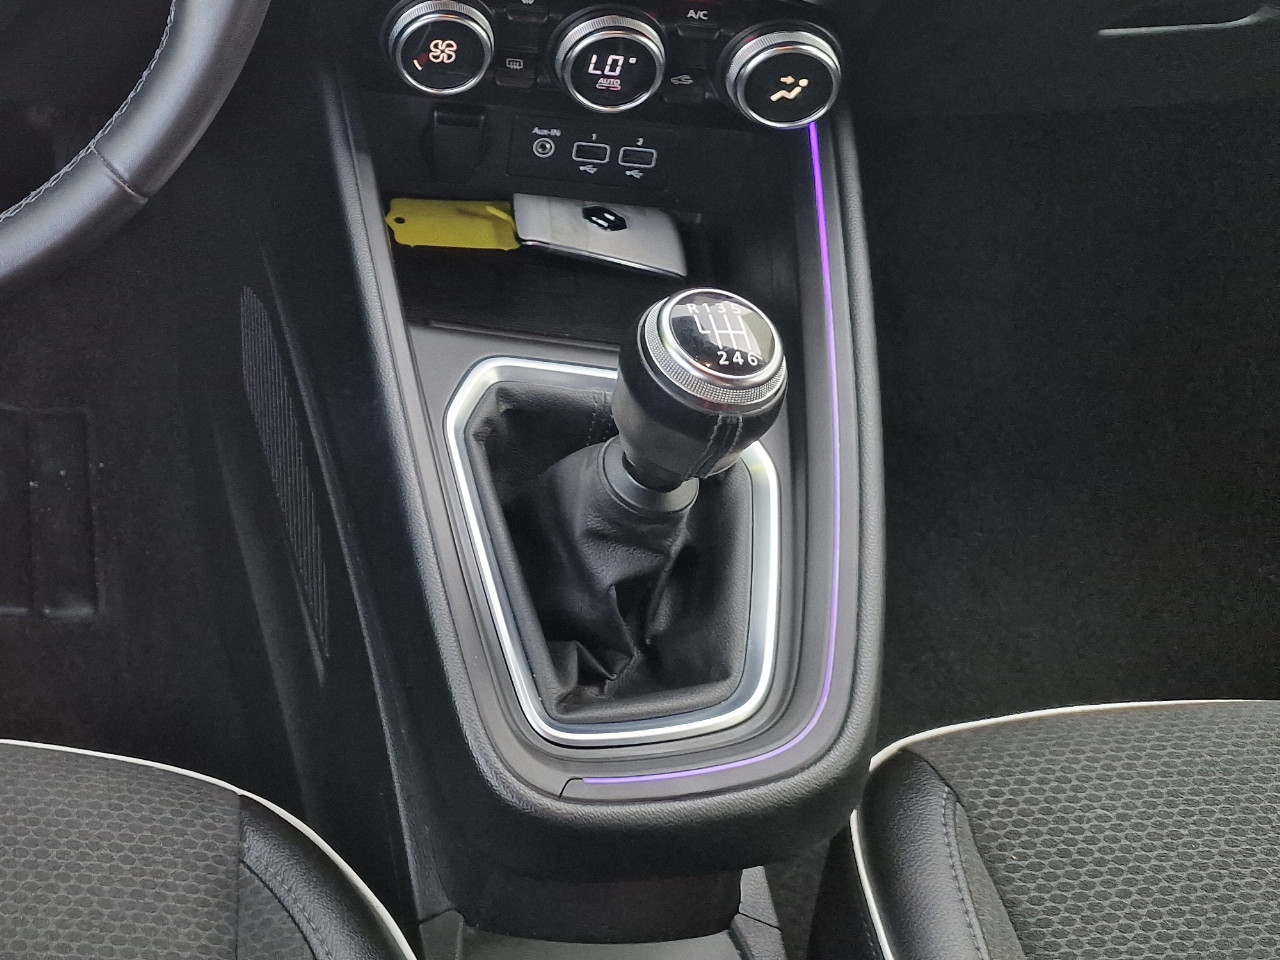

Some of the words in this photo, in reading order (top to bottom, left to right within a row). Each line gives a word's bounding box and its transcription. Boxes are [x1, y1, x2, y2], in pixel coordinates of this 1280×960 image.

[687, 9, 709, 20] A/C
[597, 77, 621, 85] AUTO
[686, 303, 699, 314] R
[701, 302, 711, 313] 1
[715, 303, 726, 313] 3
[729, 303, 741, 314] 5
[716, 351, 730, 365] 2
[732, 351, 744, 366] 4
[747, 352, 759, 366] 6
